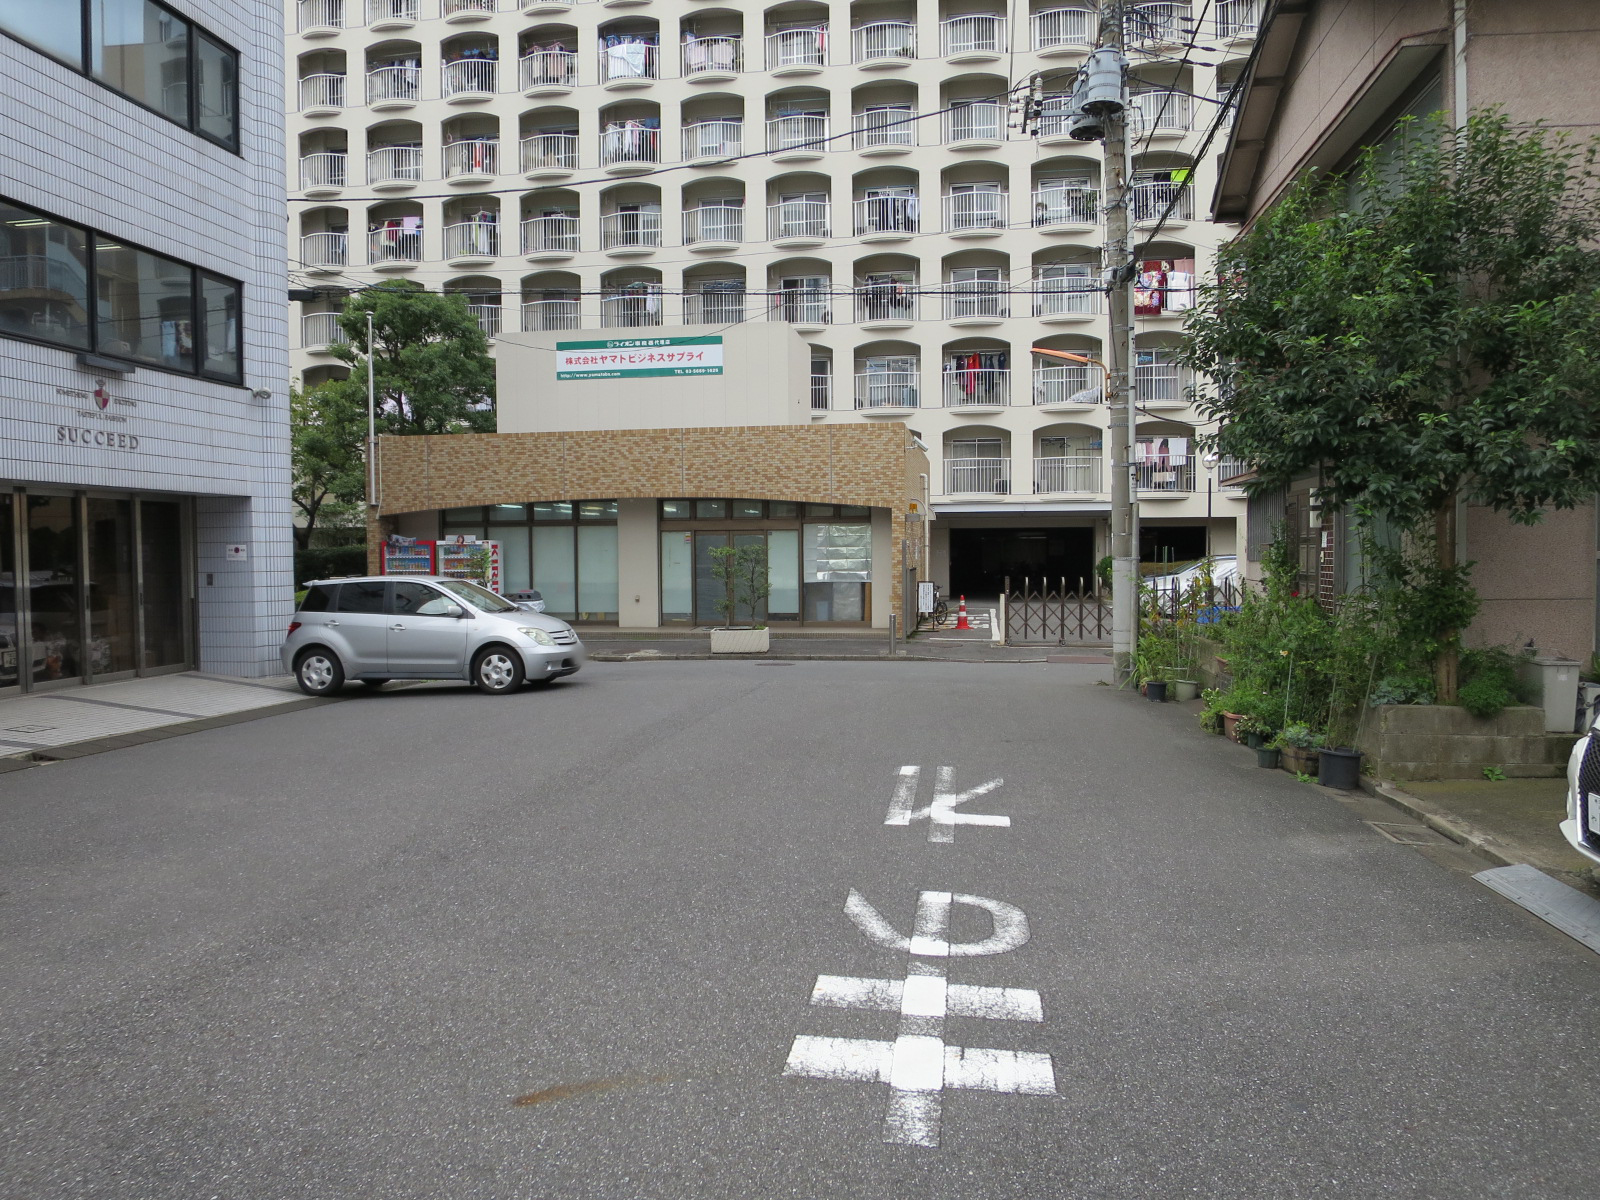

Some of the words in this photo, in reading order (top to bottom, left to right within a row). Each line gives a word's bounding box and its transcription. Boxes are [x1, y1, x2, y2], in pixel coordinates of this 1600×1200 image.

[565, 351, 704, 365] 株式会社ヤマトビジネスサプライ
[57, 426, 139, 449] SUCCEED
